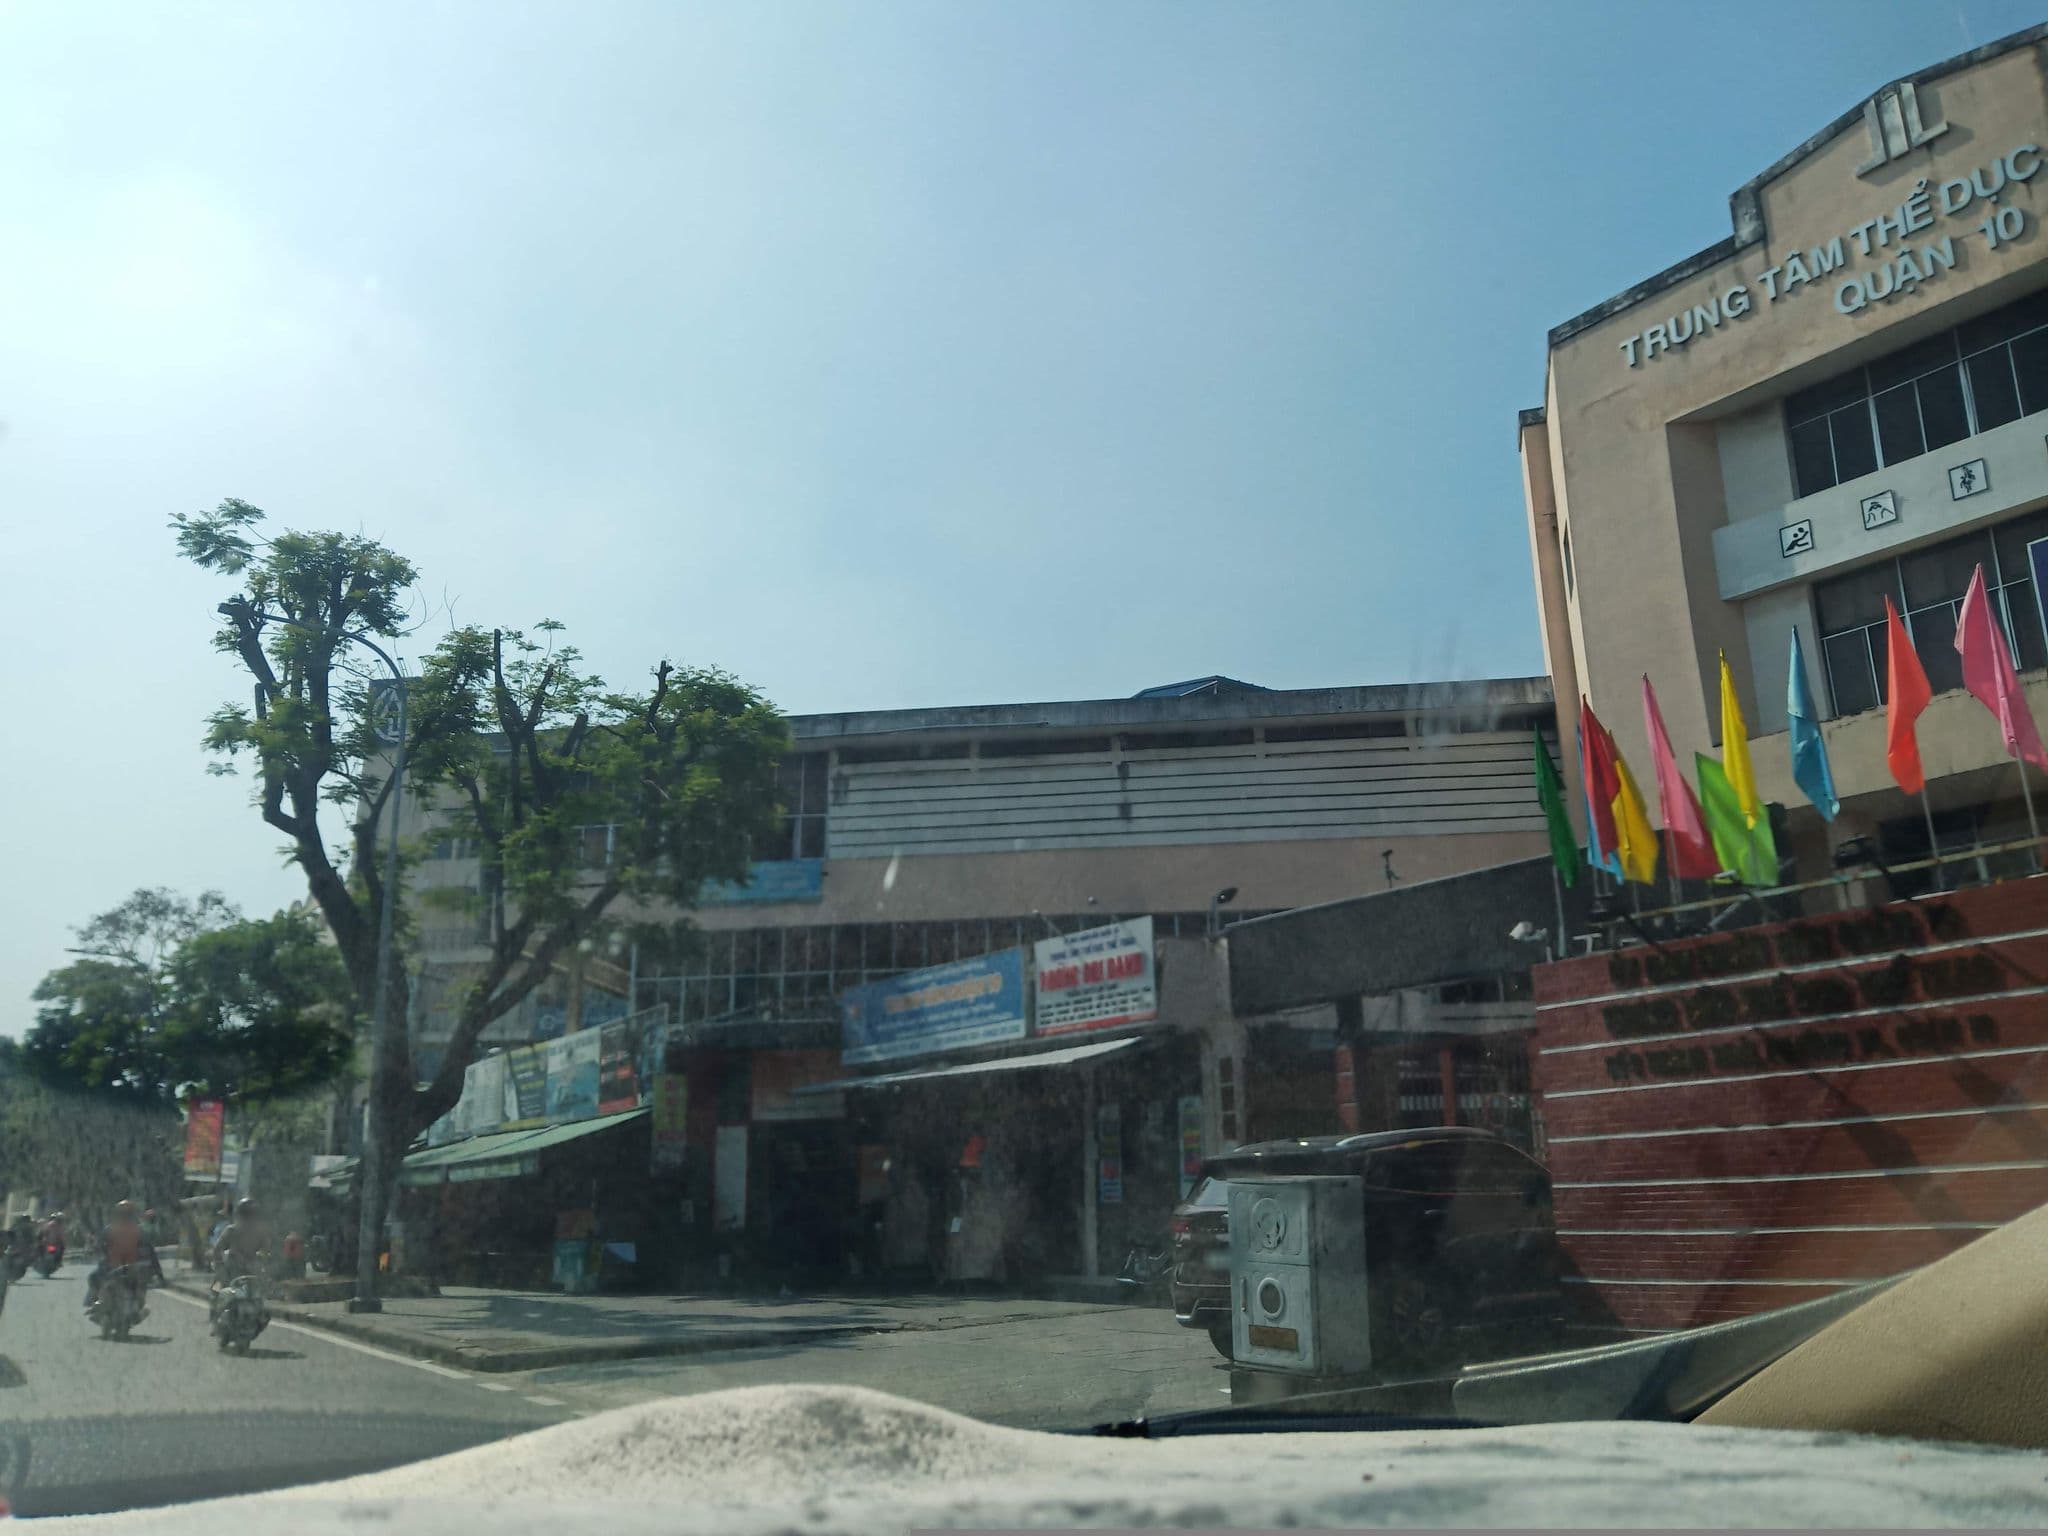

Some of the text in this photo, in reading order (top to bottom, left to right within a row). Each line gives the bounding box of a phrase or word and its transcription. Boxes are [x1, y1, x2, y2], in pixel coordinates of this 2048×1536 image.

[1619, 143, 2044, 368] TRUNG TÂM THỂ DỤC
[1833, 206, 2025, 316] QUẬN 10
